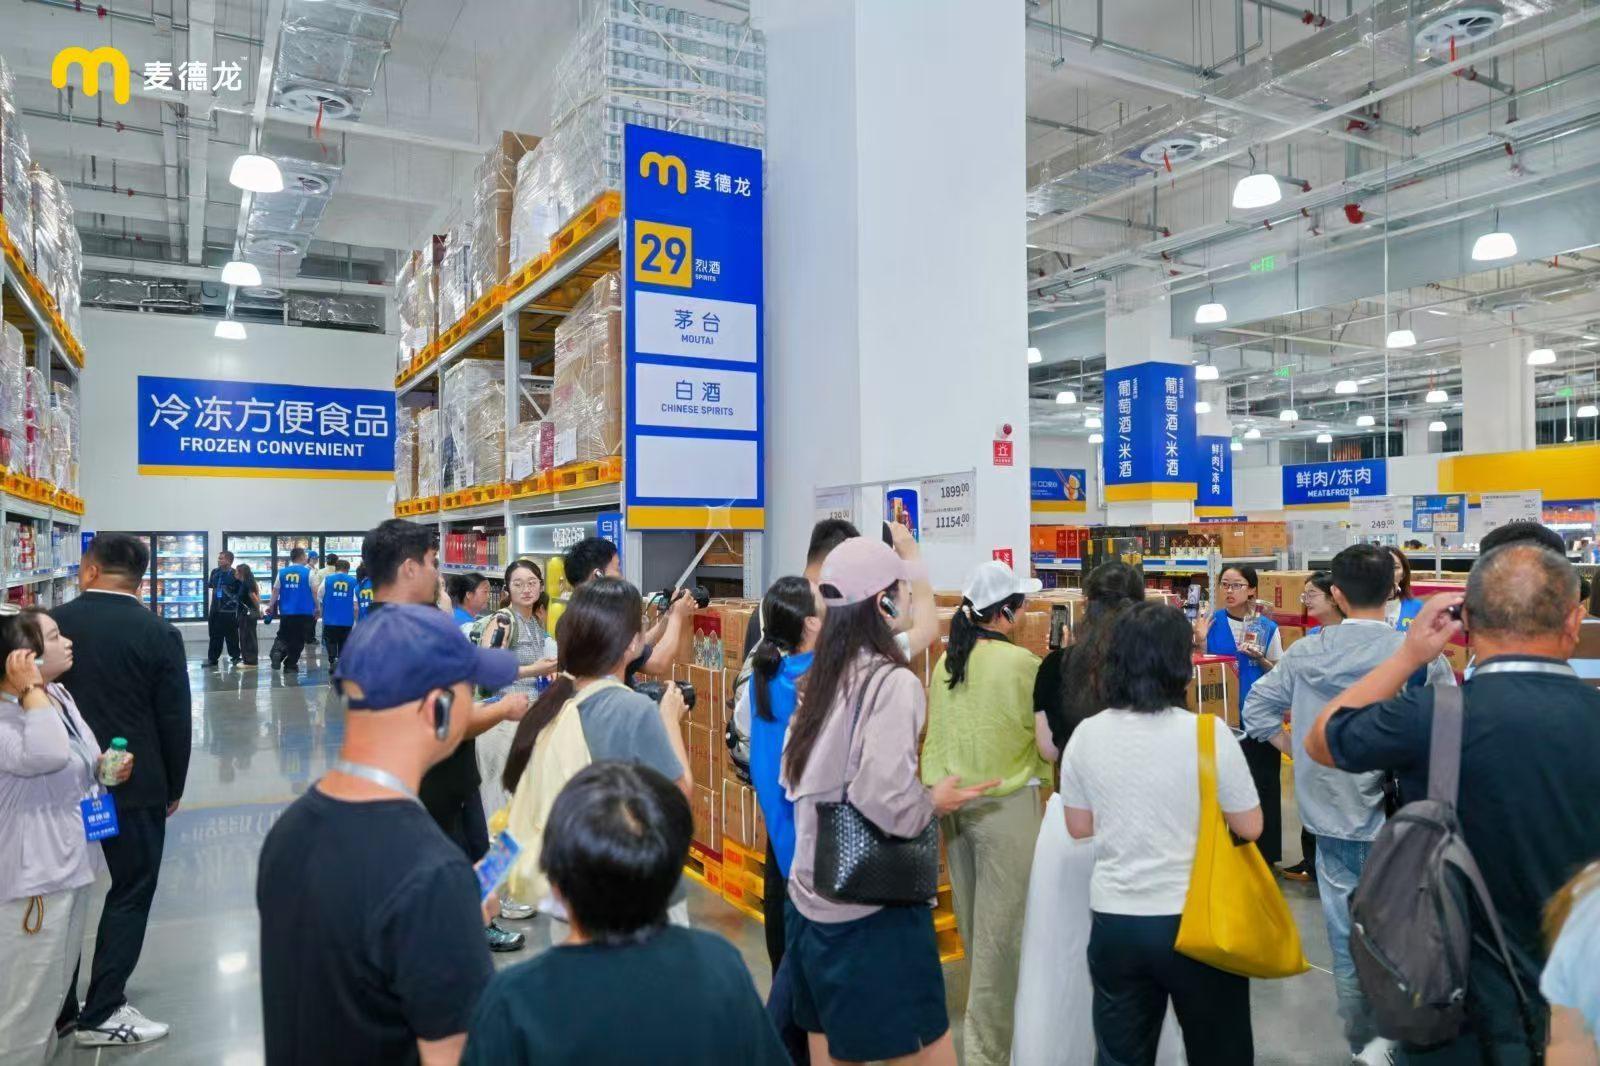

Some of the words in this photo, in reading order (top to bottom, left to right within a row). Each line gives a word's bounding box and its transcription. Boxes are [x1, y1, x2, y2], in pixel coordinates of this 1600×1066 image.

[694, 169, 752, 197] 麦德龙
[640, 233, 687, 275] 29
[695, 258, 721, 275] 烈酒
[695, 274, 717, 282] SPIRITS
[674, 309, 721, 333] 茅台
[681, 334, 714, 345] MOUTAI
[675, 380, 721, 403] 白酒
[149, 393, 389, 438] 冷冻方便食品
[661, 403, 699, 415] CHINESE
[700, 406, 734, 417] SPIRITS
[1118, 379, 1132, 478] 葡萄酒/米酒
[1165, 377, 1179, 476] 葡萄酒/米酒
[180, 436, 252, 454] FROZEN
[256, 439, 365, 457] CONVENIENT
[1296, 466, 1372, 489] 鲜肉/冻肉
[940, 482, 970, 498] 1899.00
[1307, 487, 1360, 497] MEAT&FROZEN
[935, 513, 970, 529] 11154.00
